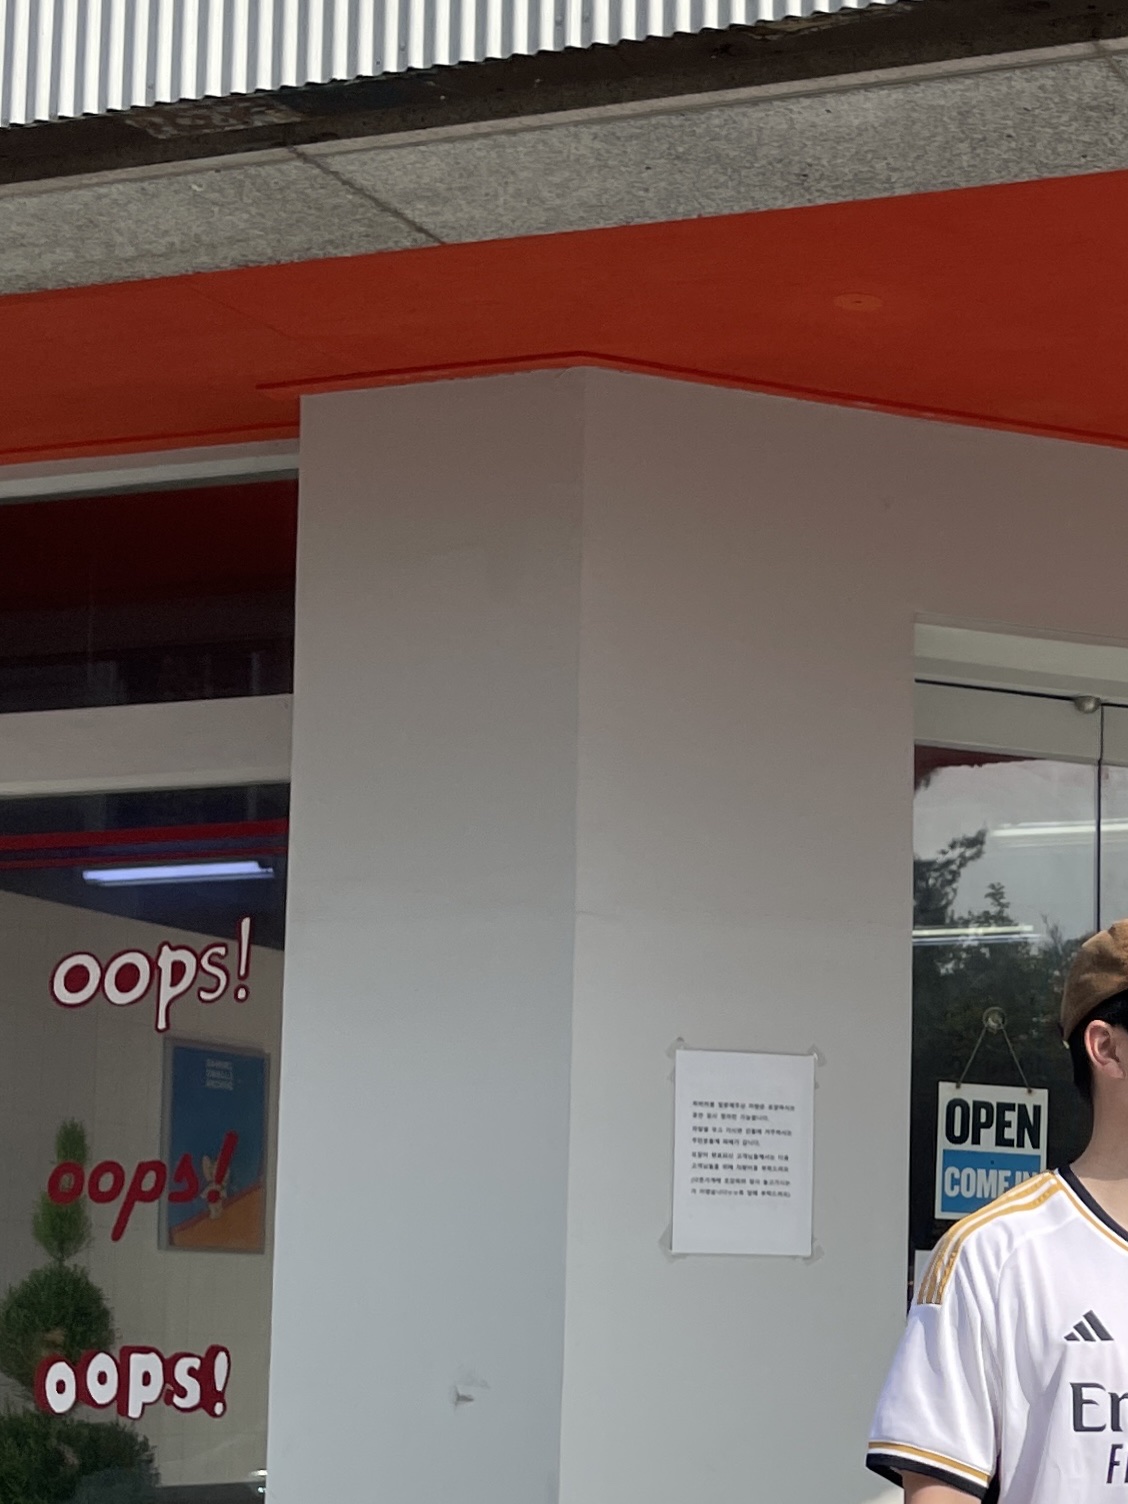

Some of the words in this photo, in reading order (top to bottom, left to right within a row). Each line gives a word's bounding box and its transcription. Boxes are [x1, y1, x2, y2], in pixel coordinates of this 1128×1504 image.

[51, 917, 253, 1032] oops!
[945, 1097, 1042, 1150] OPEN
[47, 1131, 239, 1242] oops!
[944, 1166, 1011, 1199] COME
[40, 1345, 232, 1420] oops!
